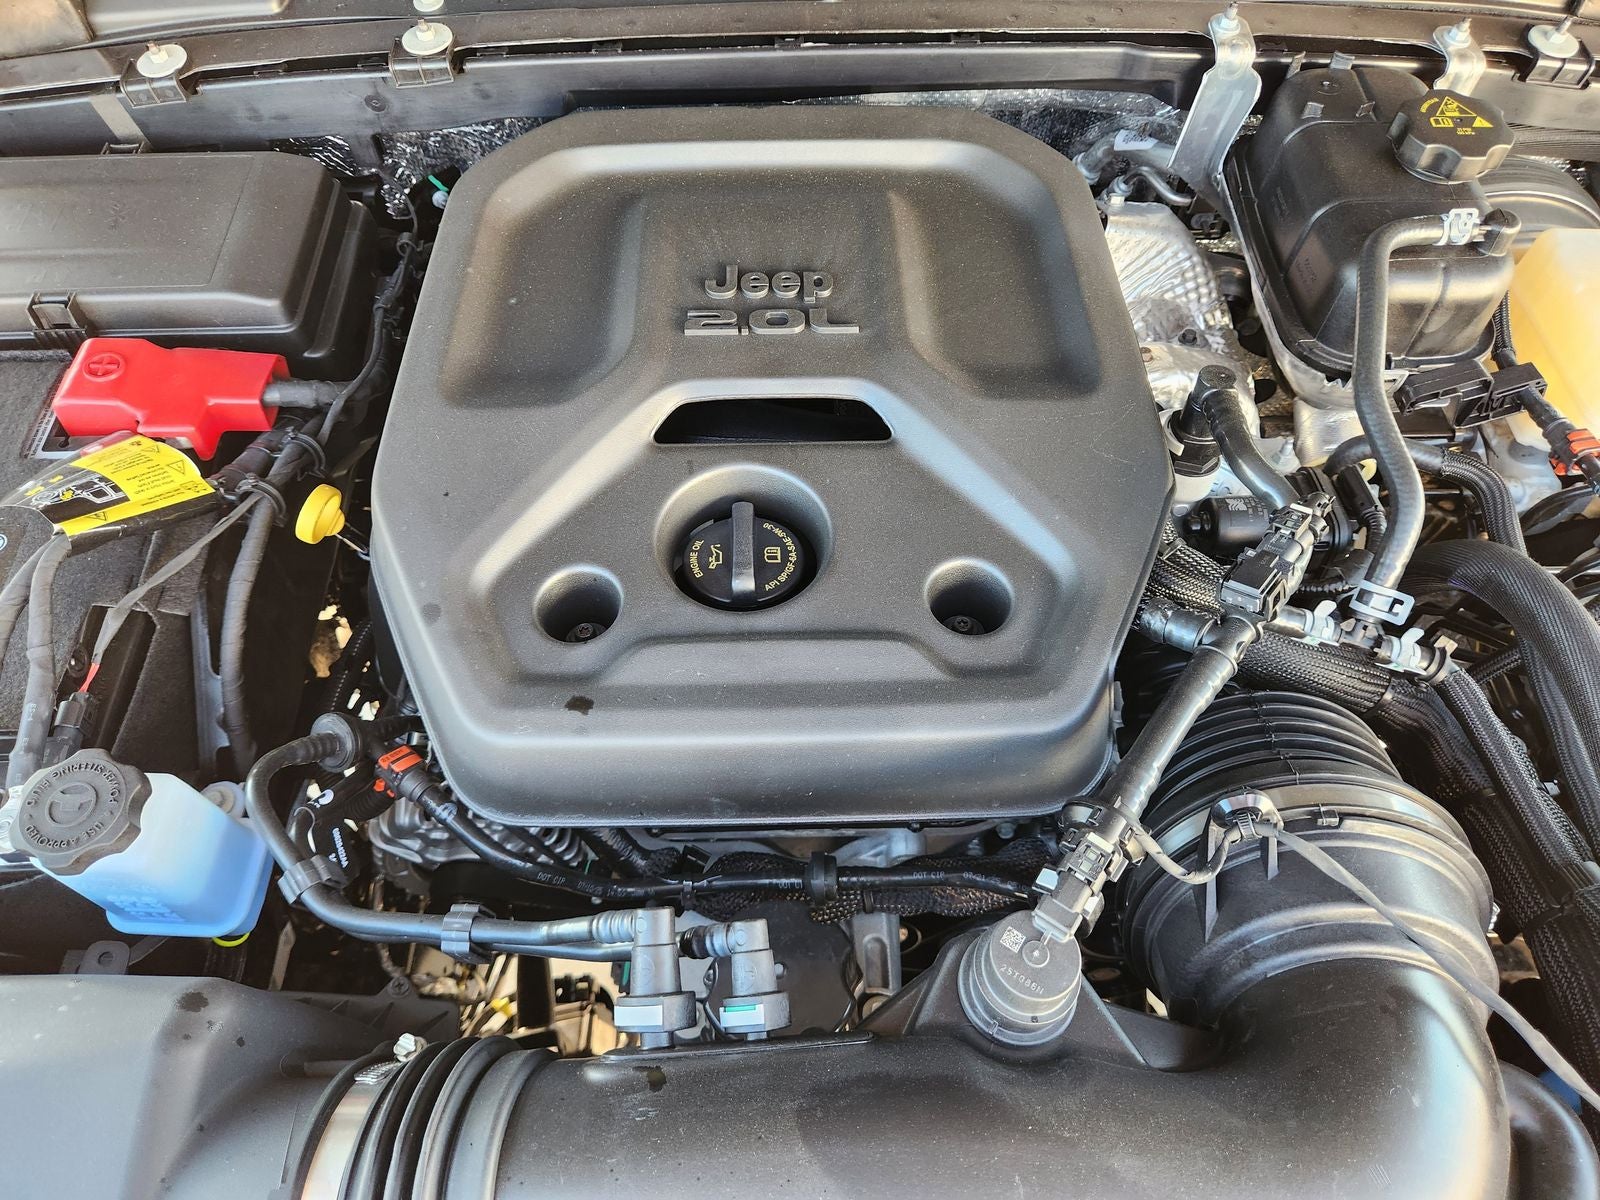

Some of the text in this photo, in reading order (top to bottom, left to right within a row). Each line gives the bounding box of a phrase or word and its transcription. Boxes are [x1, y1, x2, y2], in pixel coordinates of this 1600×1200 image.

[704, 264, 834, 304] Jeep
[684, 308, 860, 336] 2.0L
[690, 540, 705, 578] ENGINE OIL
[765, 579, 780, 591] API
